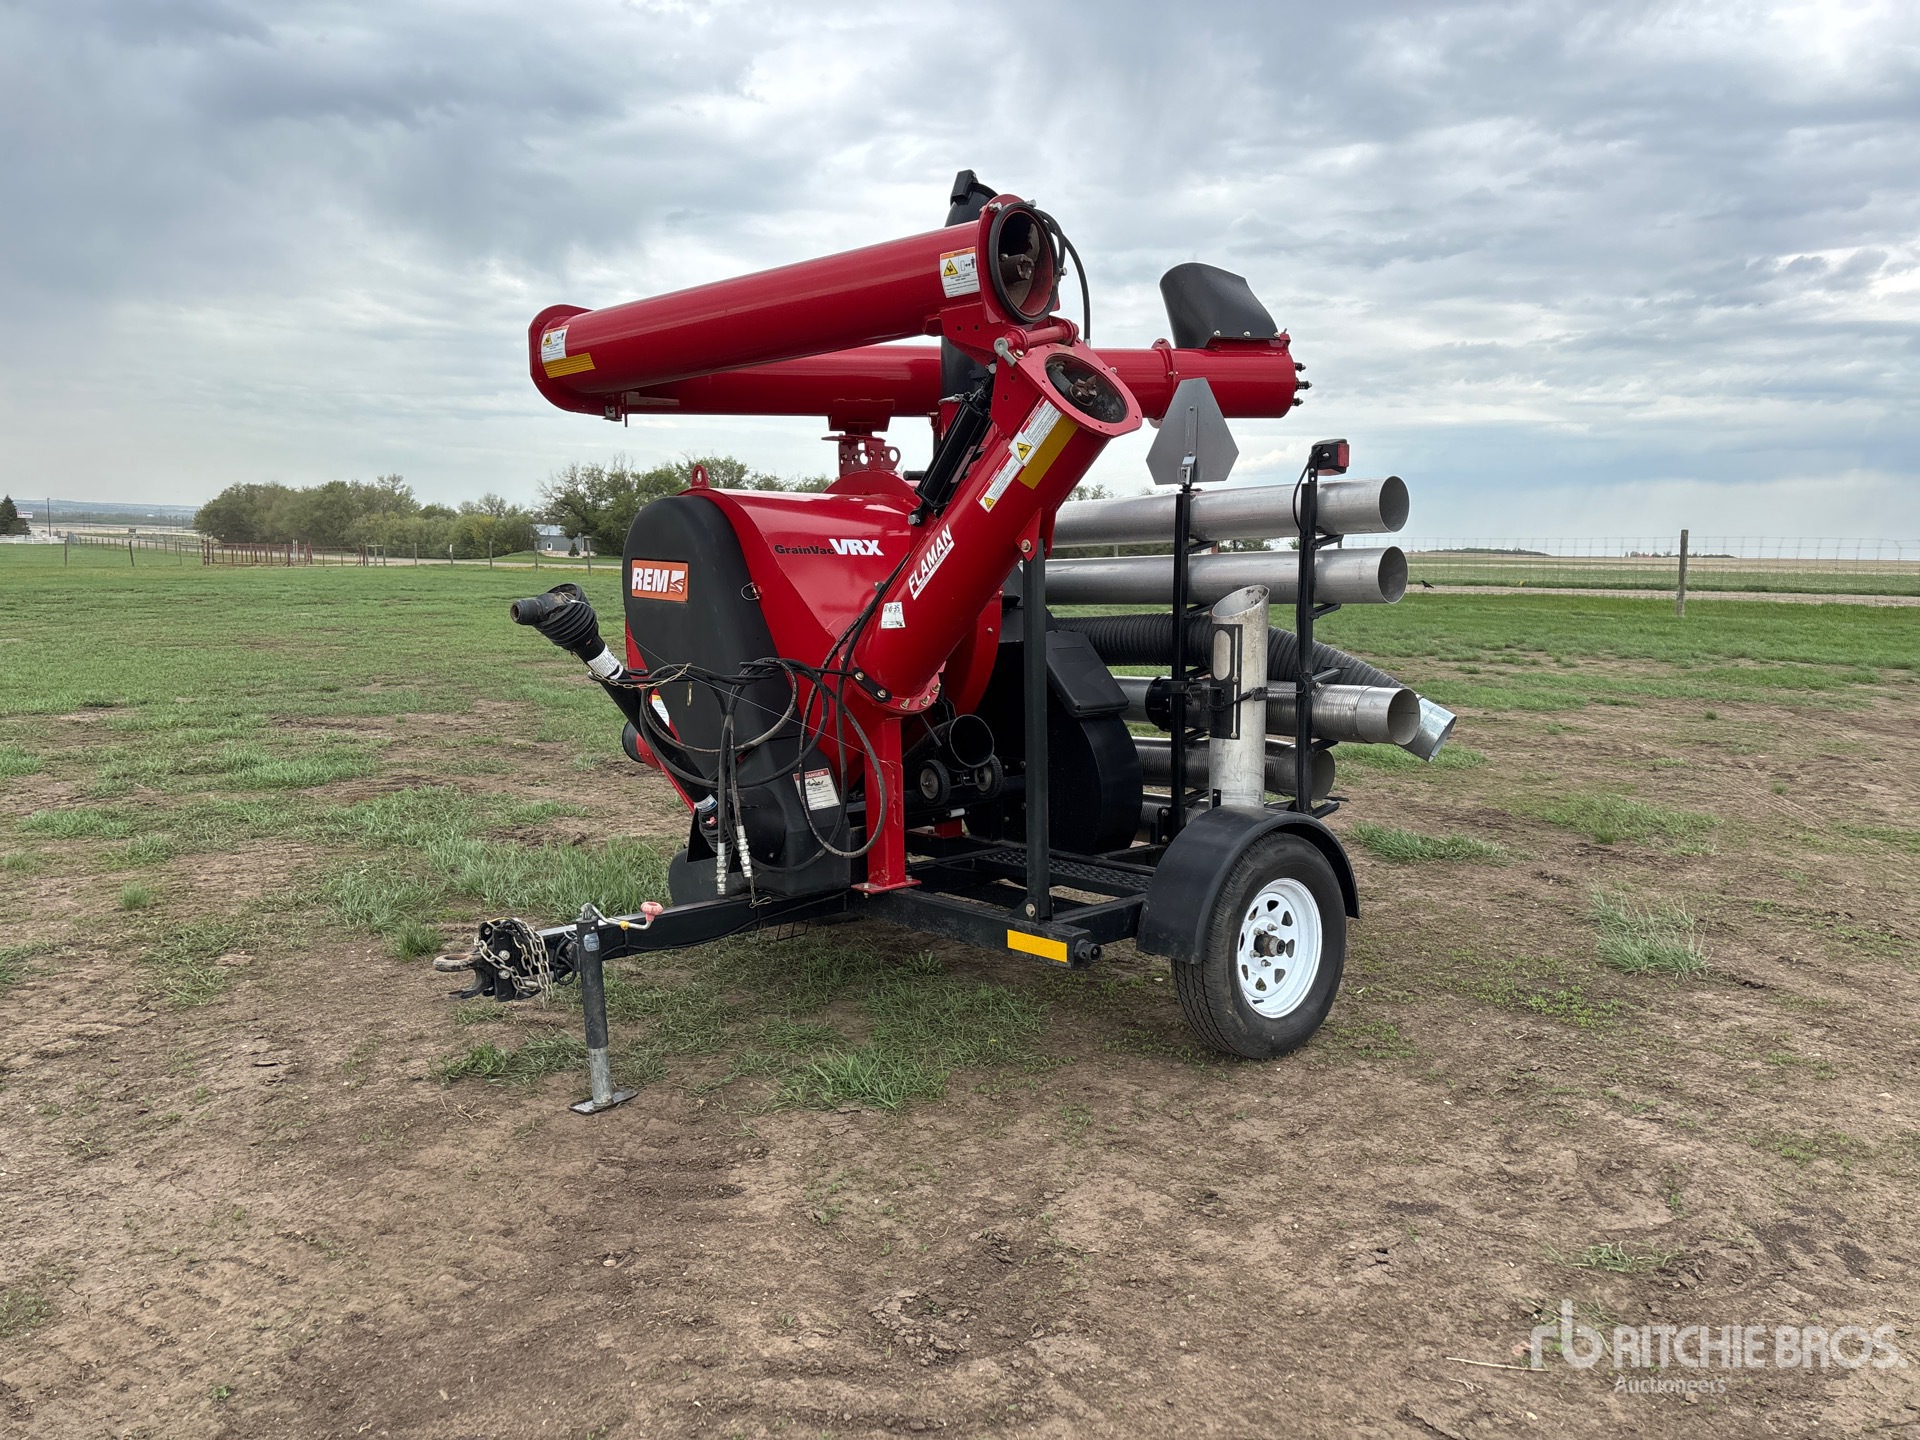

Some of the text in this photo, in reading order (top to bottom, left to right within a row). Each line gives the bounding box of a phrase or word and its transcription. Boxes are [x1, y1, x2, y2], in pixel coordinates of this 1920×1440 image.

[774, 538, 884, 556] GrainVac VRX
[908, 523, 953, 595] FLAMAN
[632, 567, 669, 593] REM
